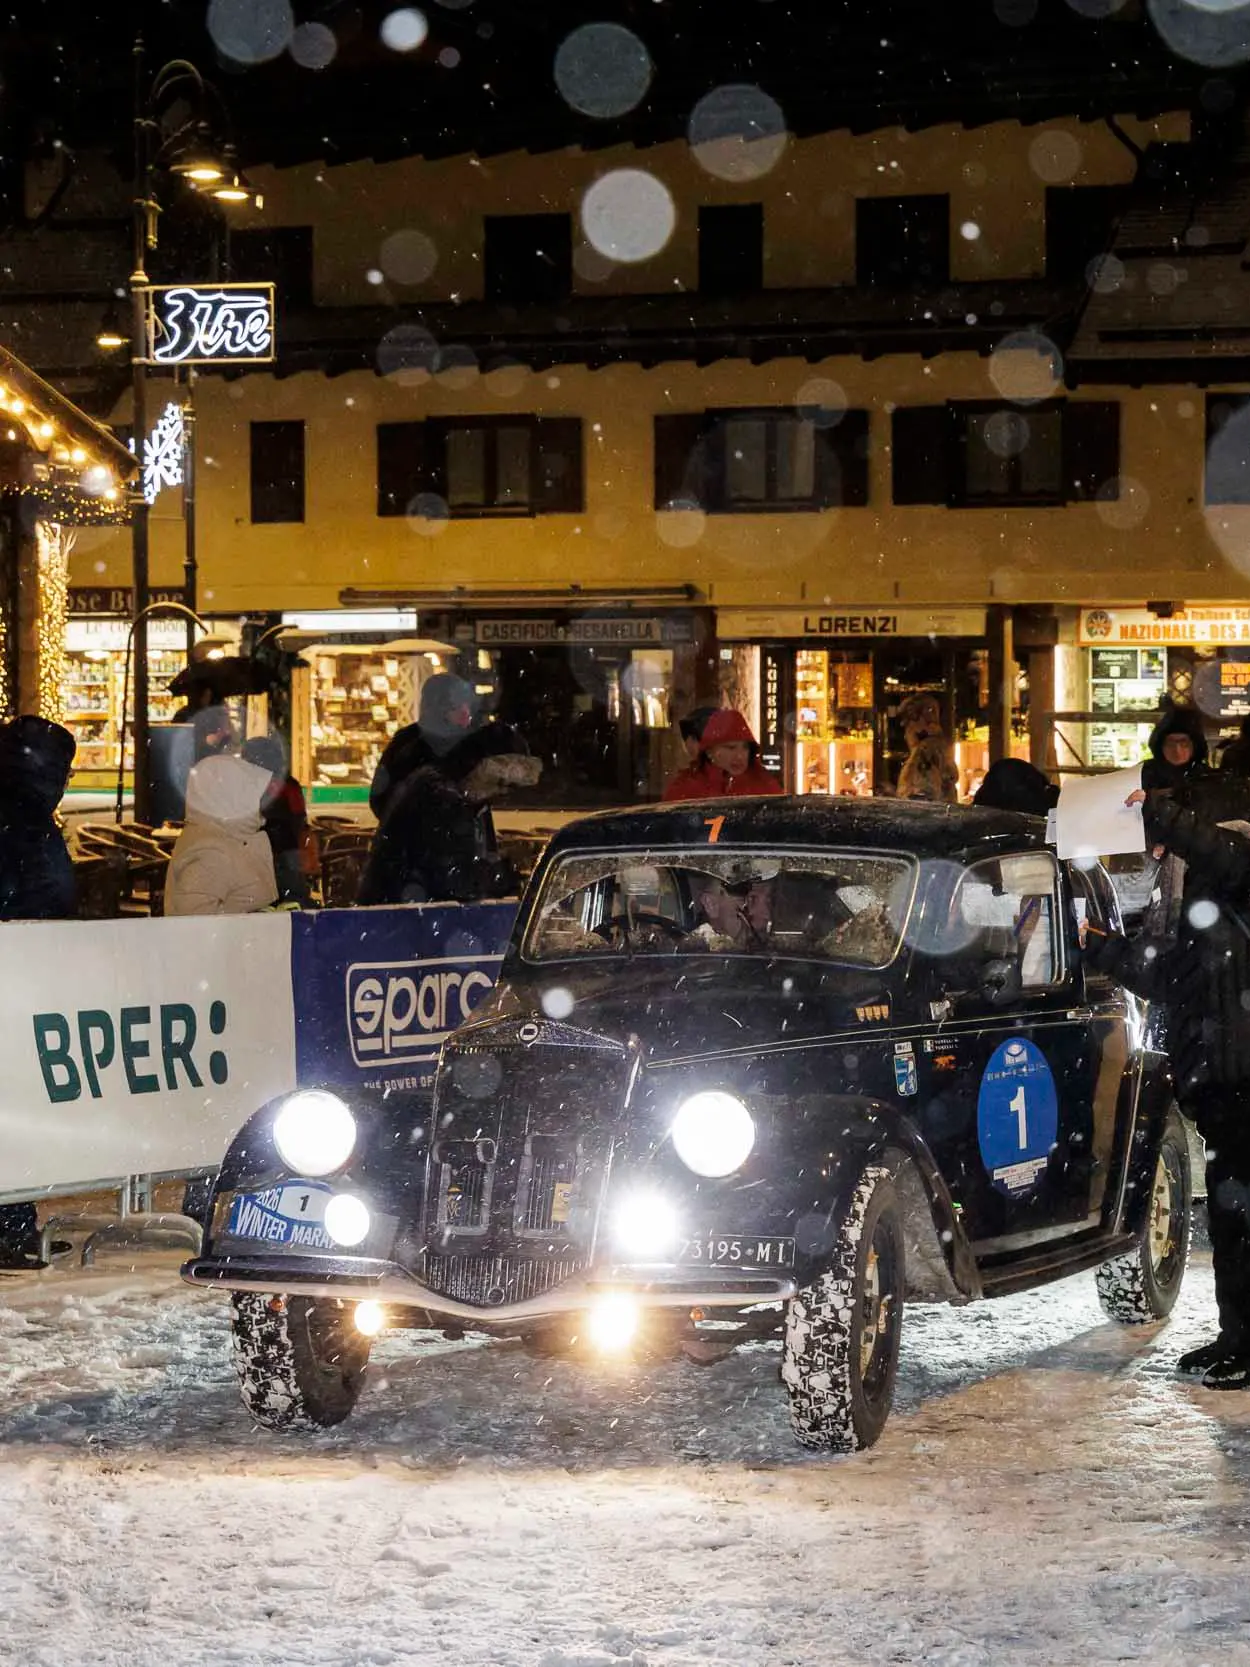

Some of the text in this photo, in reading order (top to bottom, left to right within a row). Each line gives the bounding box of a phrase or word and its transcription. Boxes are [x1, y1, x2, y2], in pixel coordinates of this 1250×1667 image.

[803, 616, 898, 633] LORENZI
[1119, 623, 1196, 639] NAZIONALE
[1209, 623, 1237, 639] DES
[767, 656, 777, 746] LORENZI
[384, 1077, 418, 1090] POWER
[420, 1075, 435, 1088] OF
[1009, 1085, 1028, 1150] 1
[255, 1187, 282, 1213] 2026
[299, 1194, 310, 1212] 1
[235, 1195, 337, 1250] WINTER MARA
[679, 1239, 785, 1264] 73195 MI
